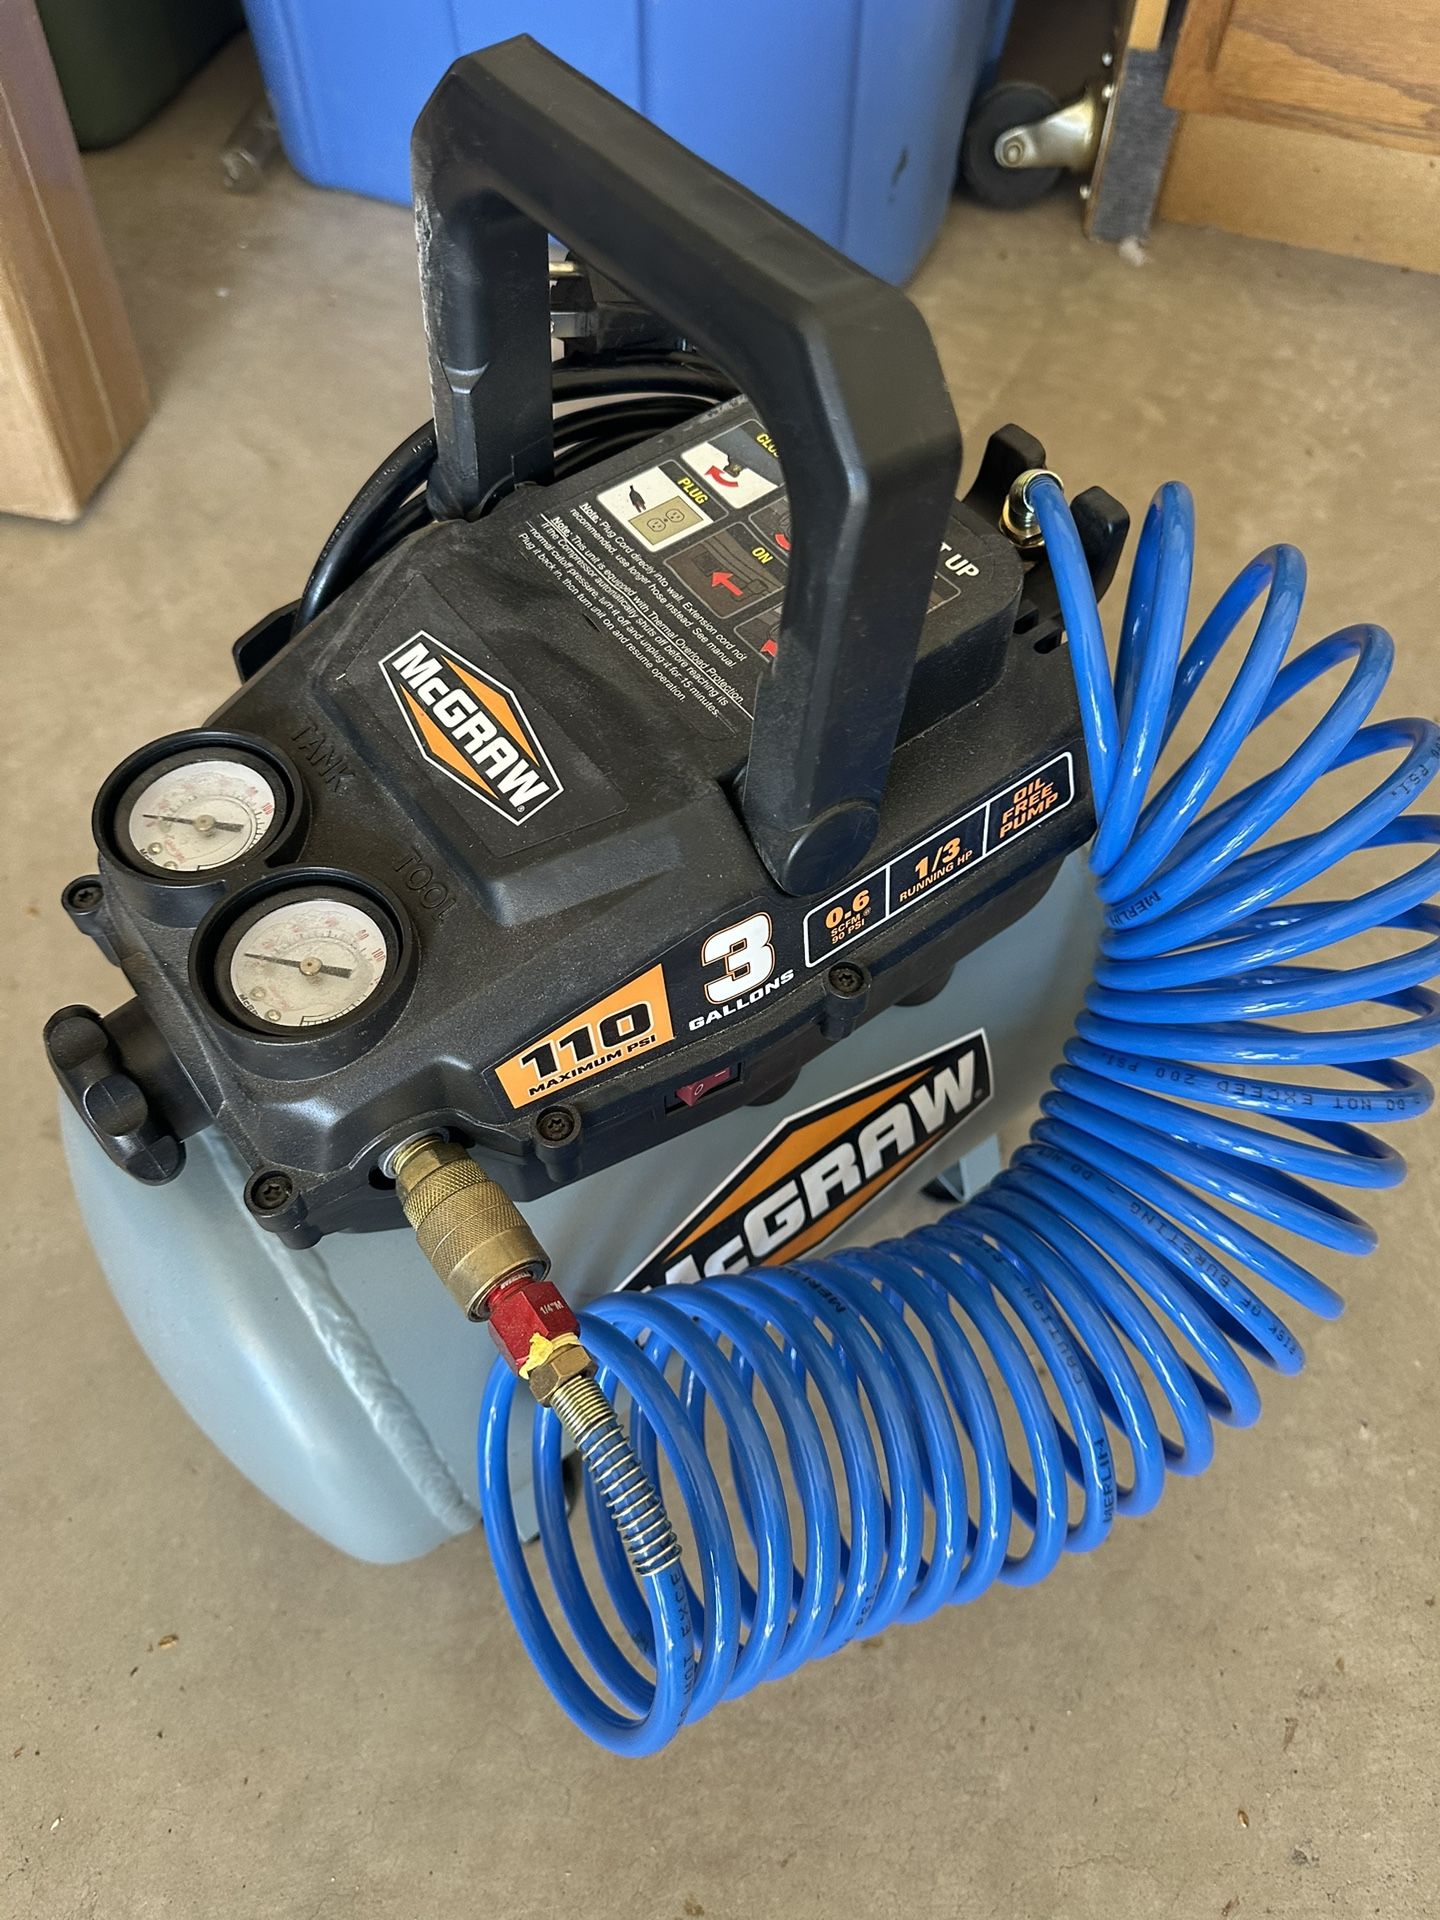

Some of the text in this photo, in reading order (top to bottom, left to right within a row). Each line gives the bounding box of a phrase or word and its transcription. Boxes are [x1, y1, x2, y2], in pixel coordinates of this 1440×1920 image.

[756, 433, 779, 458] CLO
[677, 477, 708, 505] PLUG
[579, 502, 747, 661] Note: Plug Cord directly into wall. Extension cord not
[752, 547, 774, 564] ON
[945, 553, 979, 576] UP
[551, 516, 743, 702] Note: This unit is equipped with Thermal Overload Protection.
[570, 508, 736, 668] recommended, use longer hose instead. See manual.
[518, 532, 535, 550] Plug
[537, 553, 555, 570] back
[553, 568, 562, 579] in,
[590, 606, 606, 618] unit
[602, 618, 614, 630] on
[612, 629, 630, 643] and
[625, 642, 653, 668] resume
[651, 668, 685, 701] operation.
[529, 528, 555, 551] normal
[551, 550, 573, 568] cutoff
[566, 568, 598, 598] pressure,
[616, 615, 631, 626] off
[626, 625, 644, 639] and
[640, 639, 665, 663] unplug
[680, 677, 693, 687] 15
[689, 687, 720, 717] minutes.
[557, 539, 598, 577] Compressor
[594, 577, 640, 617] automatically
[635, 617, 656, 636] shuts
[654, 635, 668, 646] off
[663, 644, 688, 667] before
[686, 666, 719, 697] reaching
[391, 642, 550, 808] McGRAW
[291, 716, 356, 793] TANK
[1000, 792, 1059, 839] PUMP
[1002, 781, 1054, 824] FREE
[1013, 777, 1046, 804] OIL
[395, 845, 457, 922] TOOL
[899, 849, 973, 902] RUNNING HP
[915, 837, 961, 880] 1/3
[825, 889, 870, 929] 0.6
[831, 913, 862, 937] SCFM
[831, 918, 866, 945] 90 PSI
[1109, 890, 1161, 927] MERLIN
[701, 911, 777, 1005] 3
[688, 969, 795, 1032] GALLONS
[520, 1001, 654, 1080] 110
[529, 1034, 657, 1097] MAXIMUM PSI
[1154, 1066, 1195, 1085] 200
[1216, 1080, 1313, 1106] EXCEED
[1332, 1098, 1372, 1111] NOT
[1129, 1200, 1231, 1289] BURSTING
[1240, 1299, 1261, 1317] OF
[1022, 1286, 1085, 1385] CAUTION
[670, 1569, 692, 1638] EXCE
